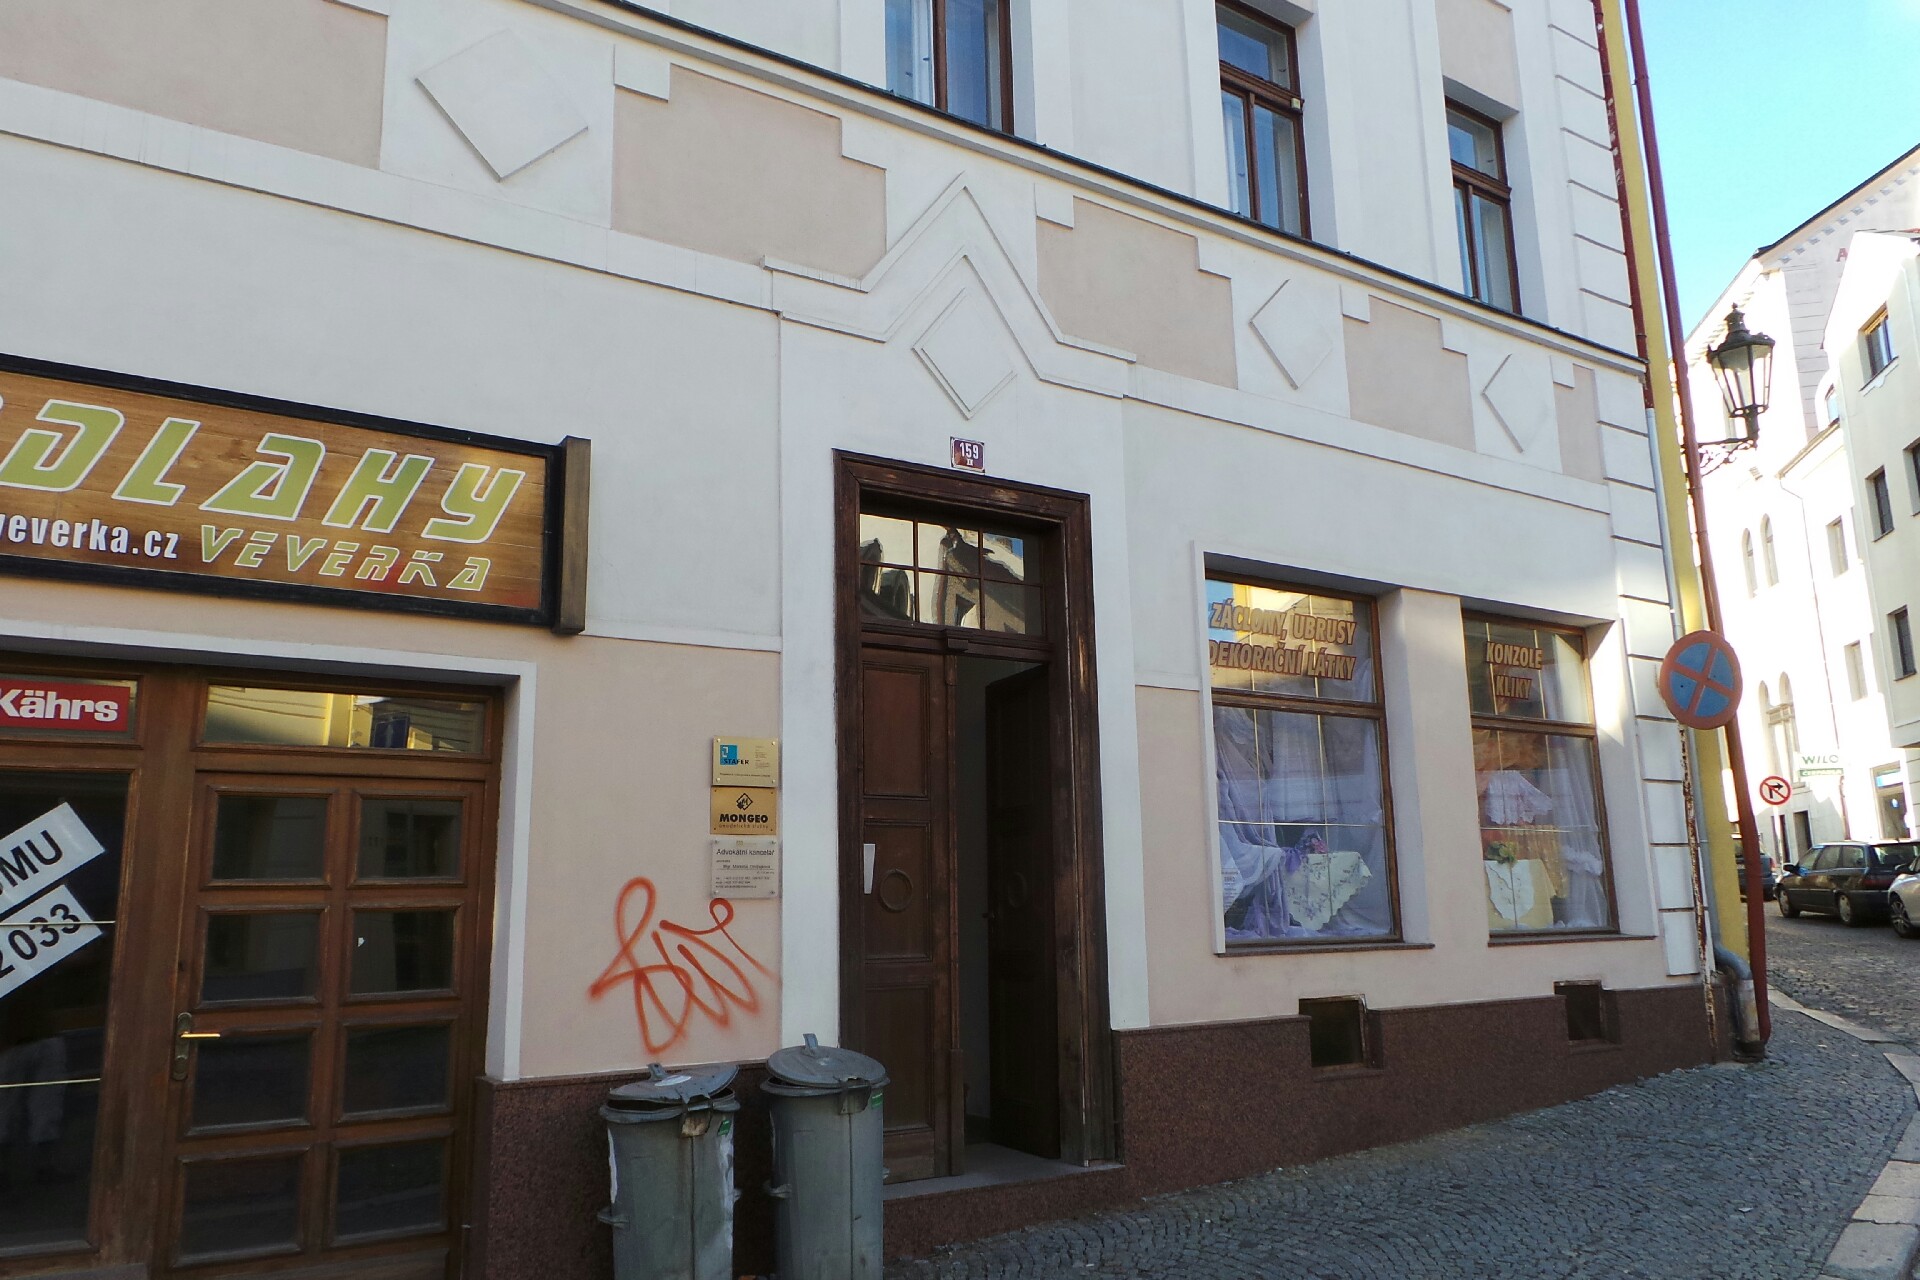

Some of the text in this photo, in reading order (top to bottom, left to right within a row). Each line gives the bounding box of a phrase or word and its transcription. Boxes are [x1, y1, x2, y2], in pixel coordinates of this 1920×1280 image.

[0, 394, 526, 545] DLAHY
[960, 442, 979, 459] 159
[201, 525, 491, 592] VEVERKA
[1210, 598, 1357, 646] ZÁCLONY, UBRUSY
[1209, 639, 1357, 681] DEKORAČNÍ LÁTKY
[1486, 641, 1543, 671] KONZOLE
[0, 688, 118, 722] Kährs
[1495, 674, 1533, 701] KLIKY
[719, 813, 769, 824] MONGEO
[0, 829, 63, 897] MU
